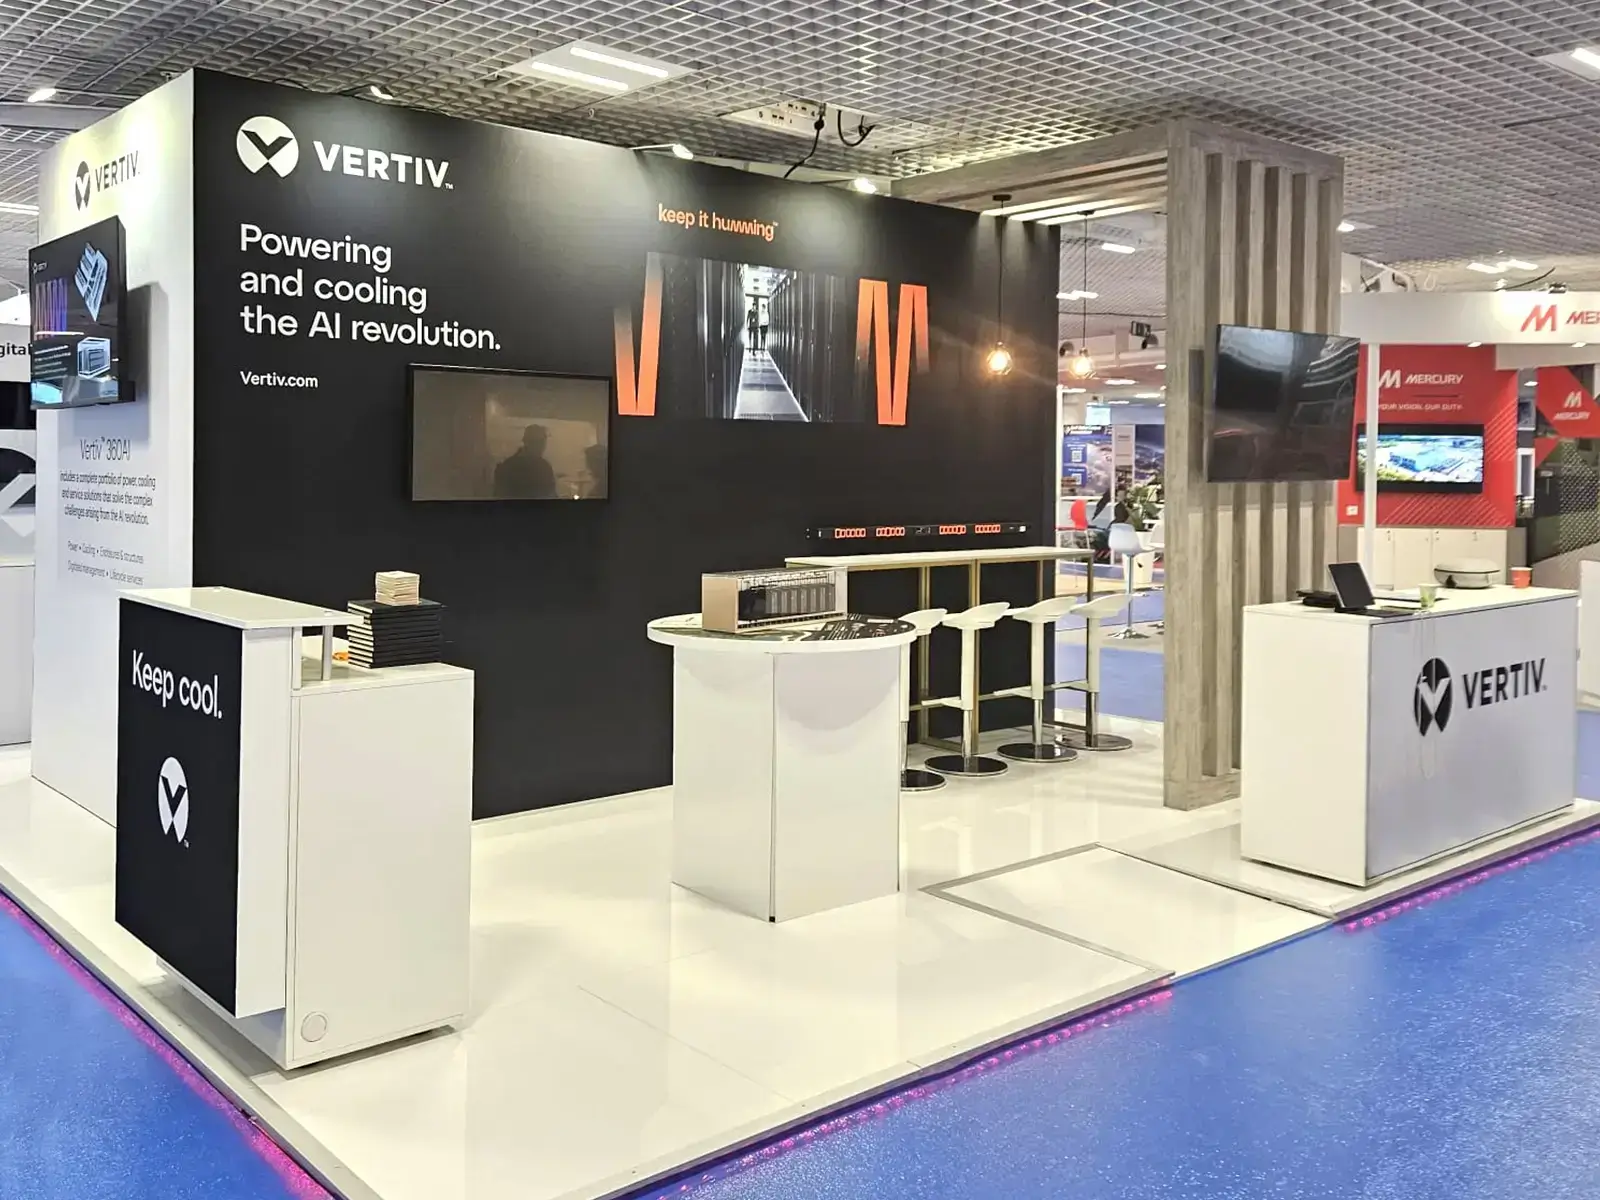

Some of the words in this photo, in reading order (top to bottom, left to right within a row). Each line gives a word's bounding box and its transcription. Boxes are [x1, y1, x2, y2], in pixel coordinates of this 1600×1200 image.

[658, 203, 696, 230] keep
[699, 210, 709, 228] it
[240, 223, 392, 273] Powering
[240, 268, 303, 298] and
[314, 276, 427, 315] cooling
[240, 305, 298, 337] the
[308, 311, 341, 340] AI
[351, 317, 501, 351] revolution.
[239, 370, 319, 389] Vertiv.com
[1405, 374, 1464, 385] MERCURY
[133, 649, 174, 708] Keep
[179, 674, 222, 719] cool.
